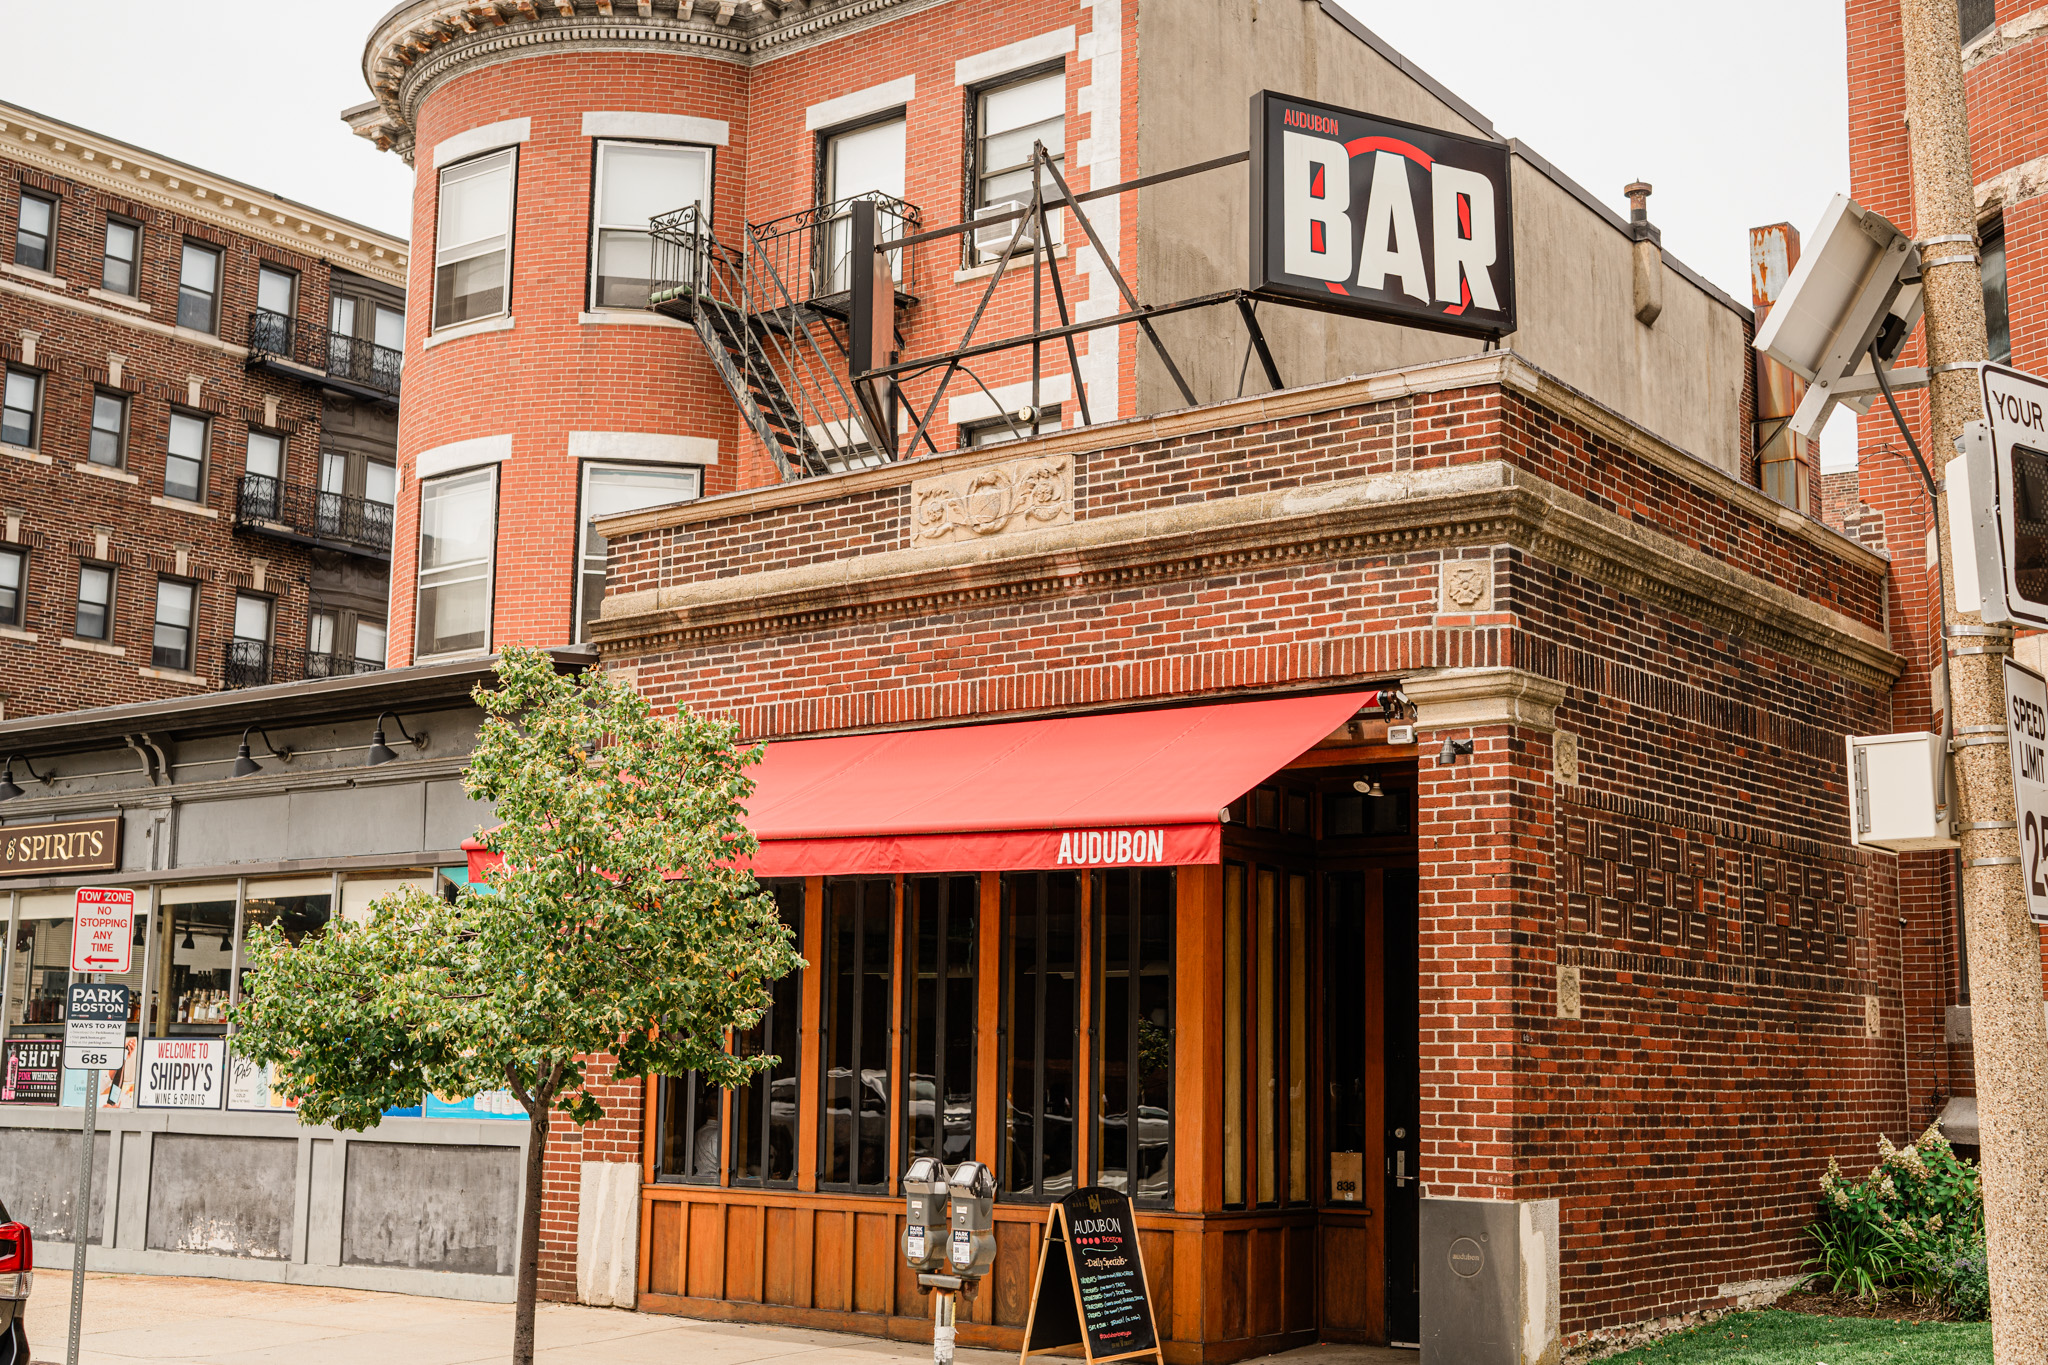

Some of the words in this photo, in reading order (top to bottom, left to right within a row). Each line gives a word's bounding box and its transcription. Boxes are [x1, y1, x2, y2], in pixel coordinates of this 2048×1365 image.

[1283, 108, 1339, 136] AUDUBON
[1283, 130, 1501, 312] BAR
[1992, 390, 2045, 433] YOUR
[2012, 694, 2046, 742] SPEED
[2018, 740, 2045, 784] LIMIT
[6, 837, 16, 862] &
[18, 830, 104, 862] SPIRITS
[1056, 829, 1164, 865] AUDUBON
[80, 891, 102, 902] TOW
[105, 891, 132, 903] ZONE
[97, 906, 112, 915] NO
[80, 918, 128, 928] STOPPING
[93, 931, 113, 940] ANY
[91, 943, 114, 952] TIME
[72, 988, 125, 1003] PARK
[71, 1003, 124, 1014] BOSTON
[158, 1042, 197, 1059] WELCOME
[198, 1043, 209, 1059] TO
[19, 1051, 60, 1067] SHOT
[81, 1054, 107, 1064] 685
[18, 1072, 31, 1080] PINK
[31, 1072, 58, 1081] WHITNEY
[150, 1062, 213, 1091] SHIPPY'S
[154, 1093, 172, 1105] WINE
[173, 1093, 178, 1105] &
[179, 1093, 206, 1106] SPIRITS
[1336, 1181, 1356, 1191] 838
[1074, 1217, 1122, 1234] AUDUBON
[1452, 1253, 1480, 1261] audubon
